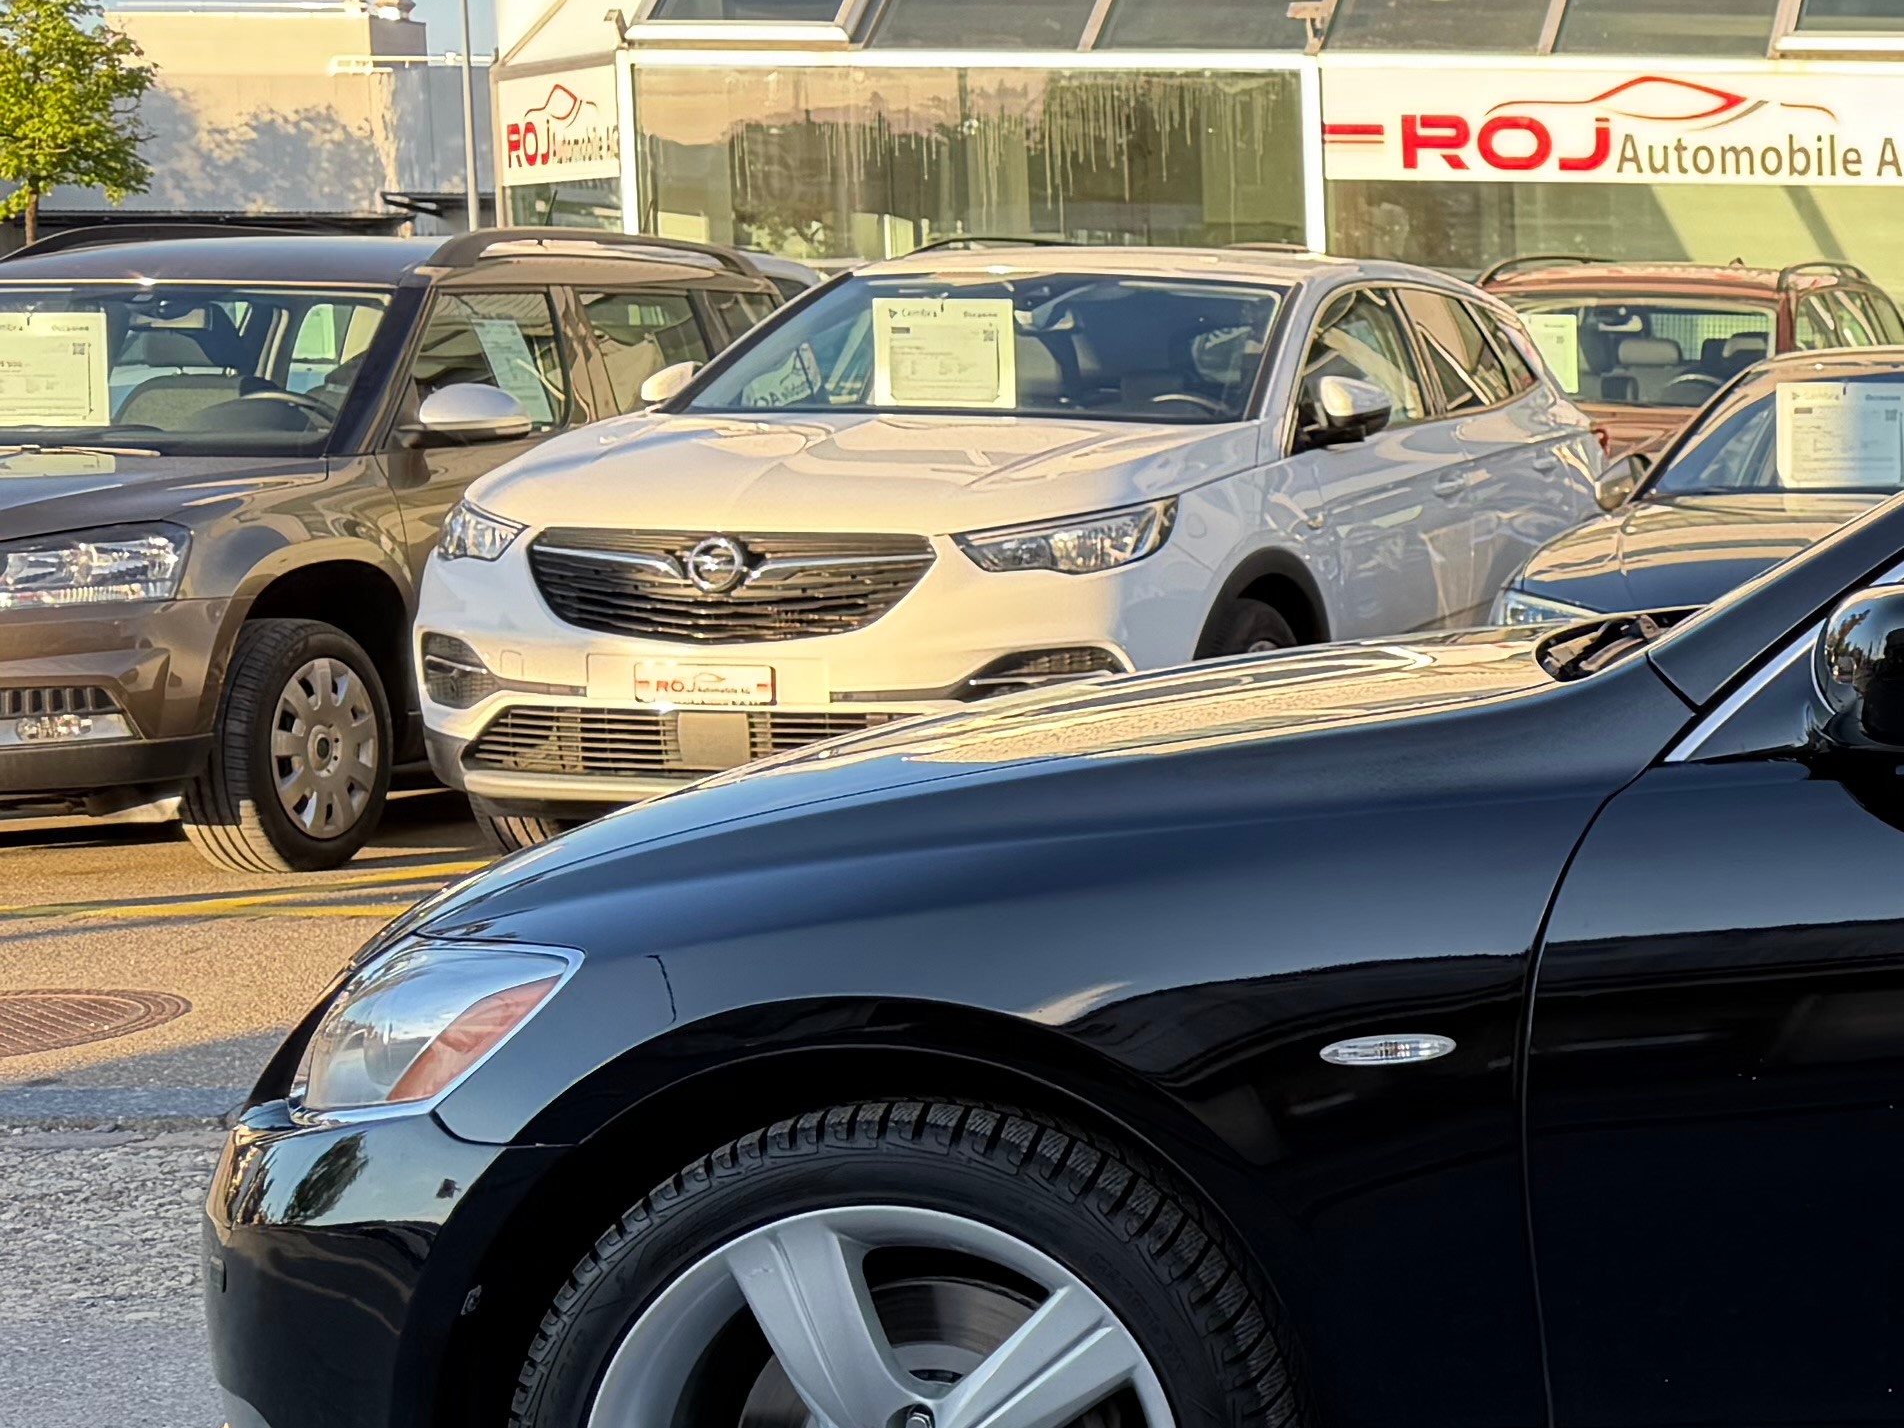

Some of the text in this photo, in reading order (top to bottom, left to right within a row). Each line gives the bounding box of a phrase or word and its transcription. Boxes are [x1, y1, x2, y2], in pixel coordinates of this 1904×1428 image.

[507, 119, 551, 167] ROJ
[1401, 114, 1611, 170] ROJ
[1616, 133, 1862, 176] Automobile
